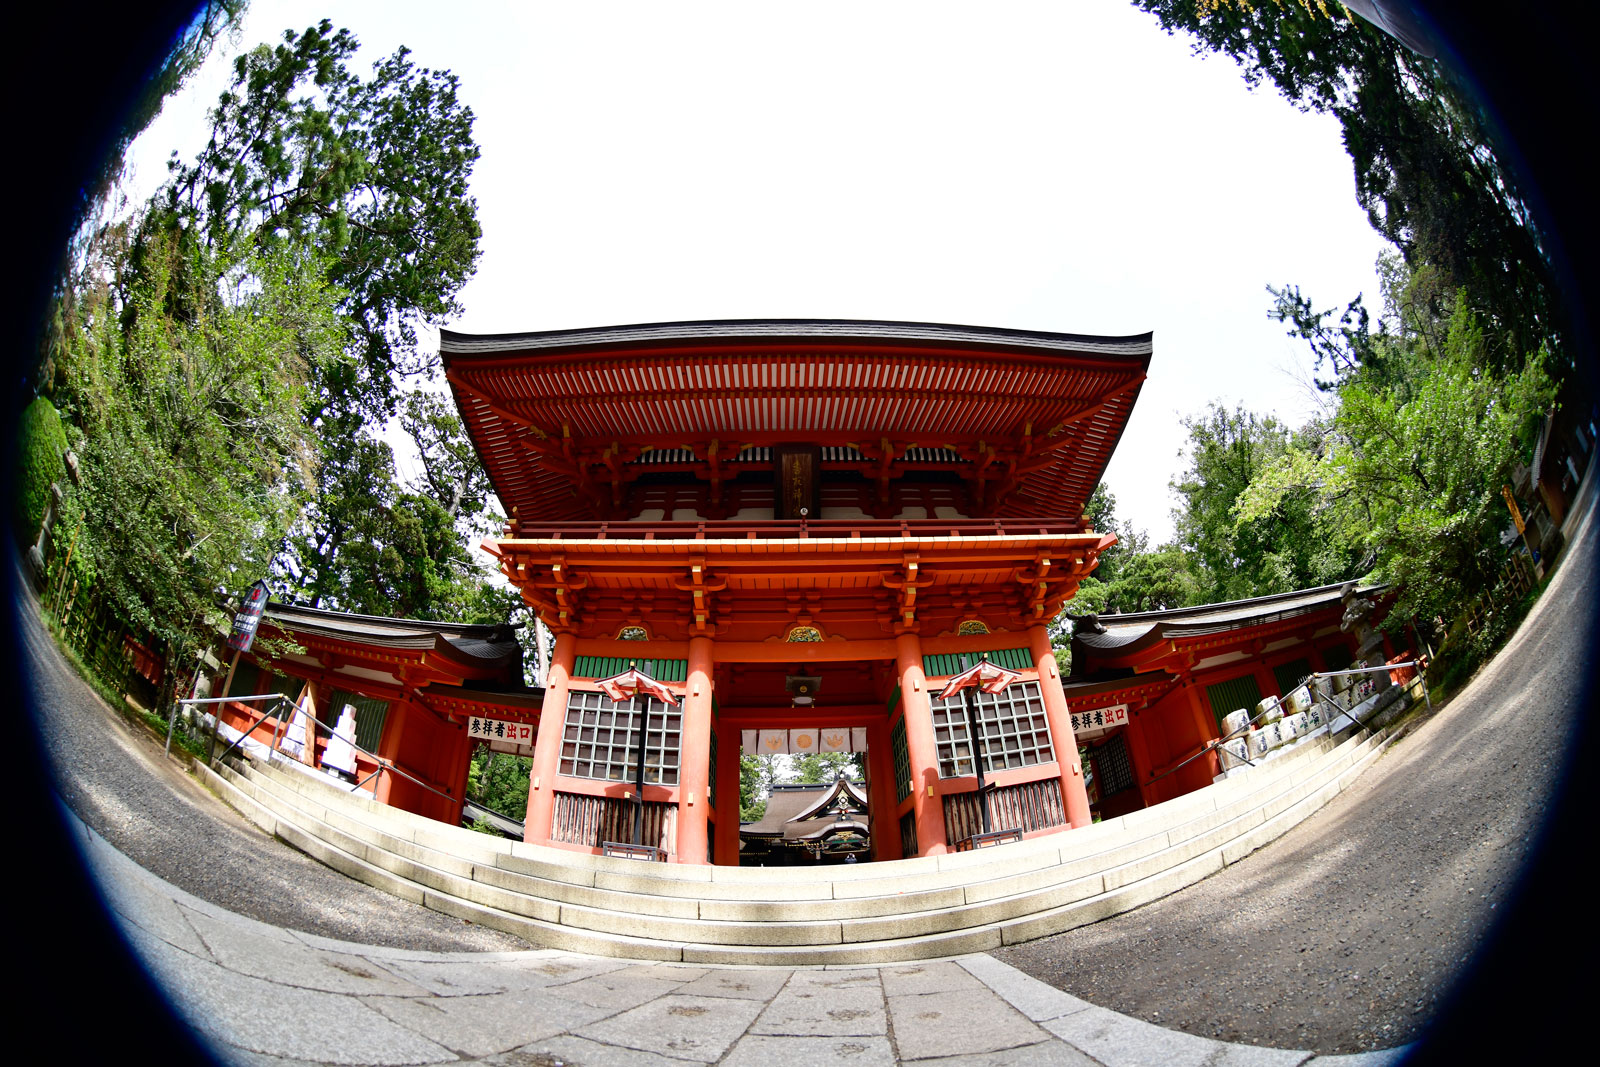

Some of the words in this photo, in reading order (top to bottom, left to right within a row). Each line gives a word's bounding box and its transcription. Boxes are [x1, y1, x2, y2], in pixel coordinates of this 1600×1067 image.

[471, 718, 530, 739] 参拝者出口
[1071, 709, 1124, 730] 参拝者出口
